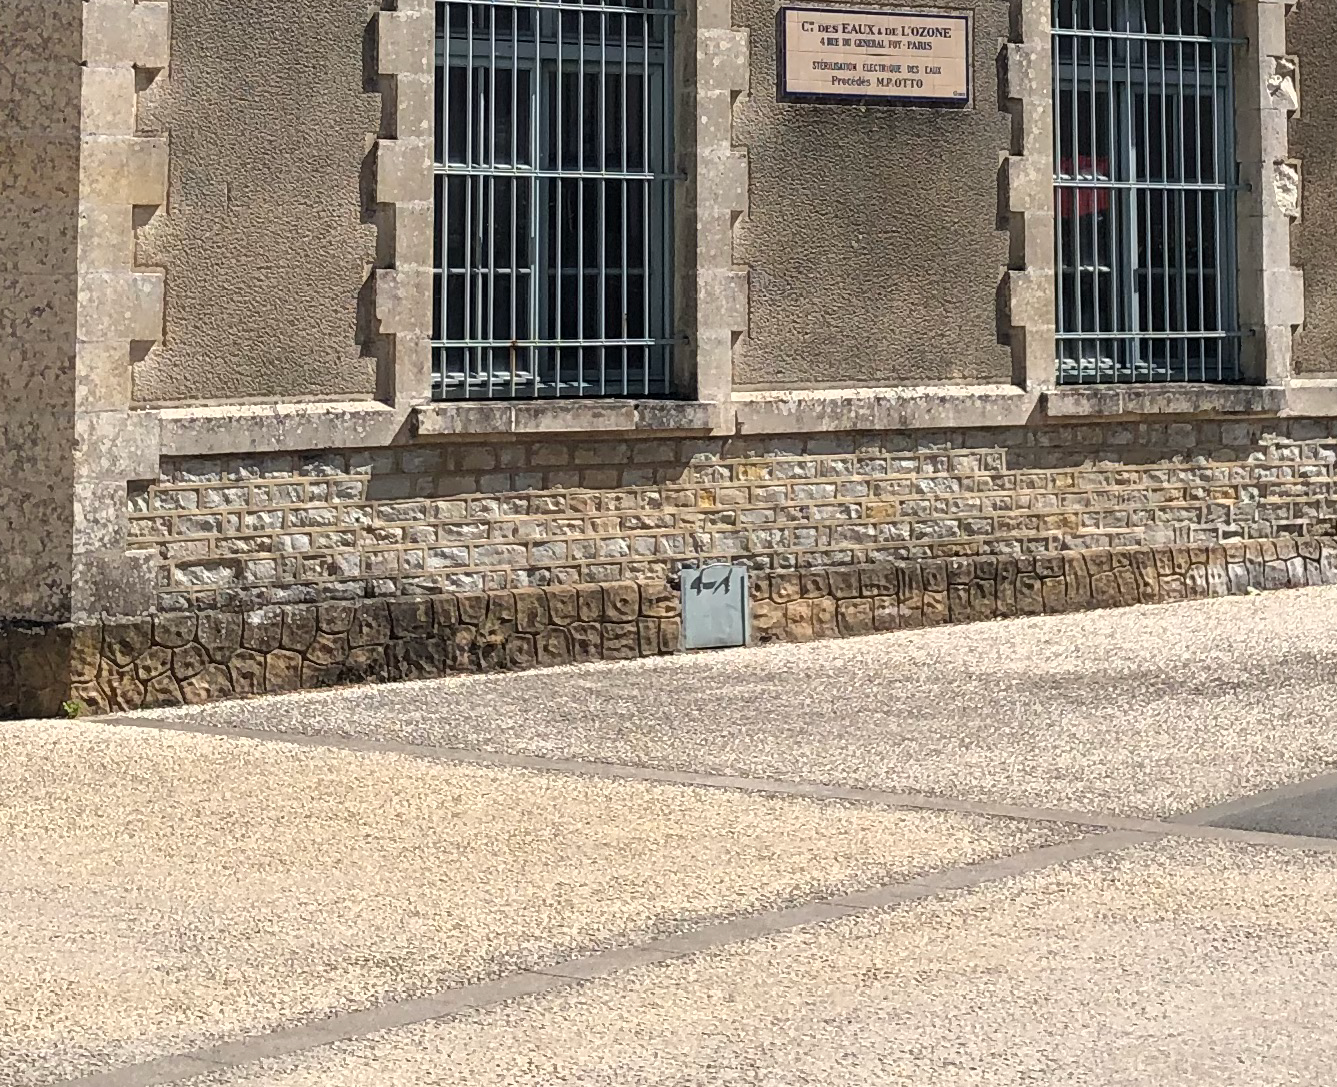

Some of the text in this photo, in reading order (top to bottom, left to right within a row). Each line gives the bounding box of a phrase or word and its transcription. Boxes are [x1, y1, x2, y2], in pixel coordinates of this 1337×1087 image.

[818, 24, 839, 34] DES
[841, 23, 876, 35] EAUX
[885, 27, 898, 36] DE
[901, 25, 951, 38] L'OZONE
[819, 37, 826, 46] 4
[827, 37, 839, 47] RUE
[842, 38, 852, 47] DU
[888, 40, 902, 49] FOY
[907, 41, 933, 50] PARIS
[907, 65, 919, 74] DES
[925, 65, 941, 74] EAUX
[831, 75, 871, 86] Procédés
